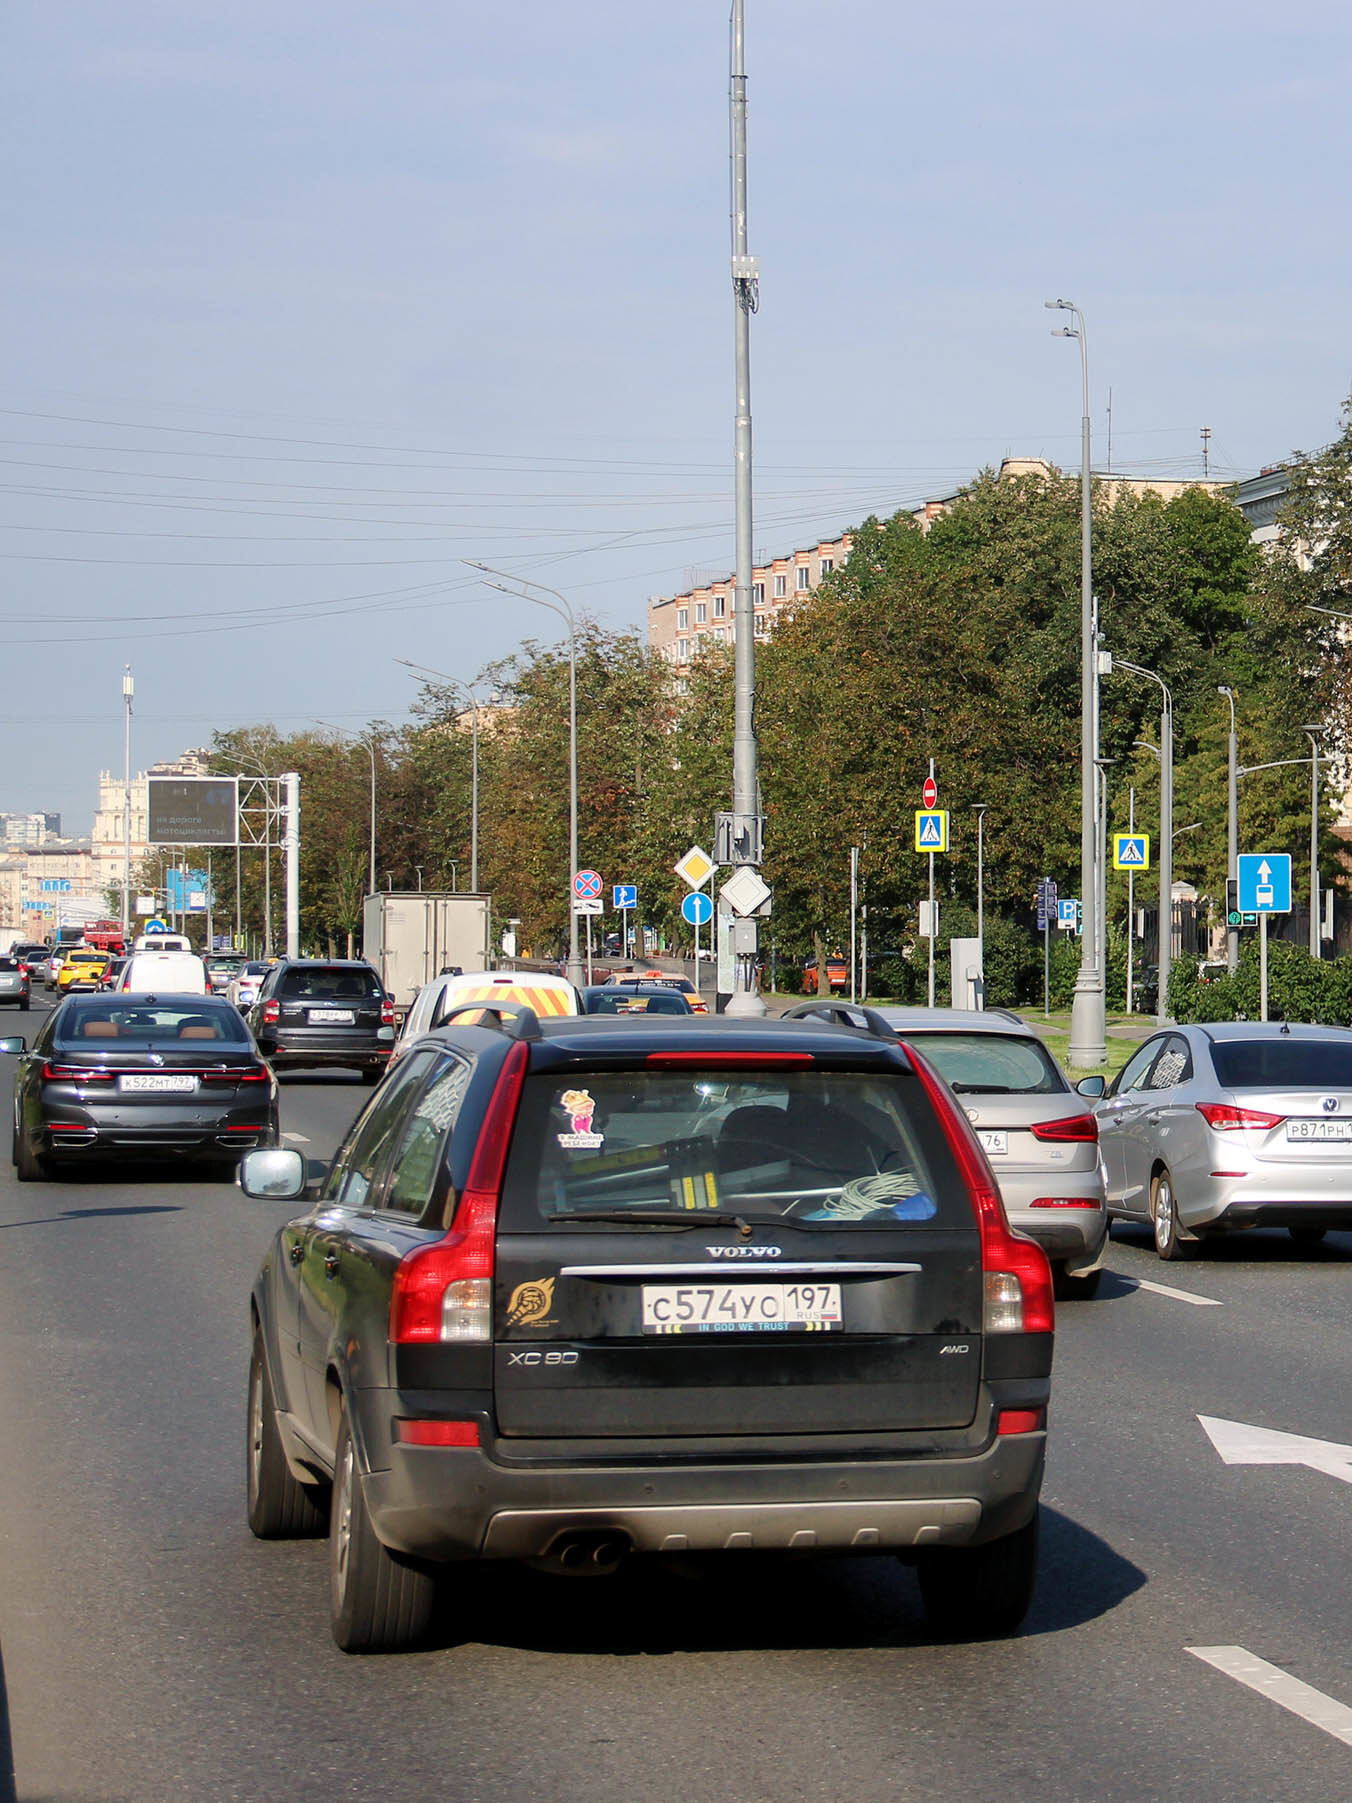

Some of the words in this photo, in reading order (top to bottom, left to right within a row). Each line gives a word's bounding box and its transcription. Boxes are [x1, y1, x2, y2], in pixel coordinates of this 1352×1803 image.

[125, 1077, 170, 1088] К522МТ
[1291, 1123, 1344, 1137] Р871РН
[985, 1134, 1001, 1147] 76
[705, 1246, 782, 1258] VOLVO
[653, 1288, 779, 1321] С574УС
[786, 1286, 831, 1310] 197
[797, 1311, 819, 1320] RUS
[698, 1324, 710, 1332] IN
[714, 1323, 736, 1332] GOD
[739, 1323, 754, 1331] WE
[758, 1321, 791, 1331] TRUST
[940, 1345, 969, 1354] AWD
